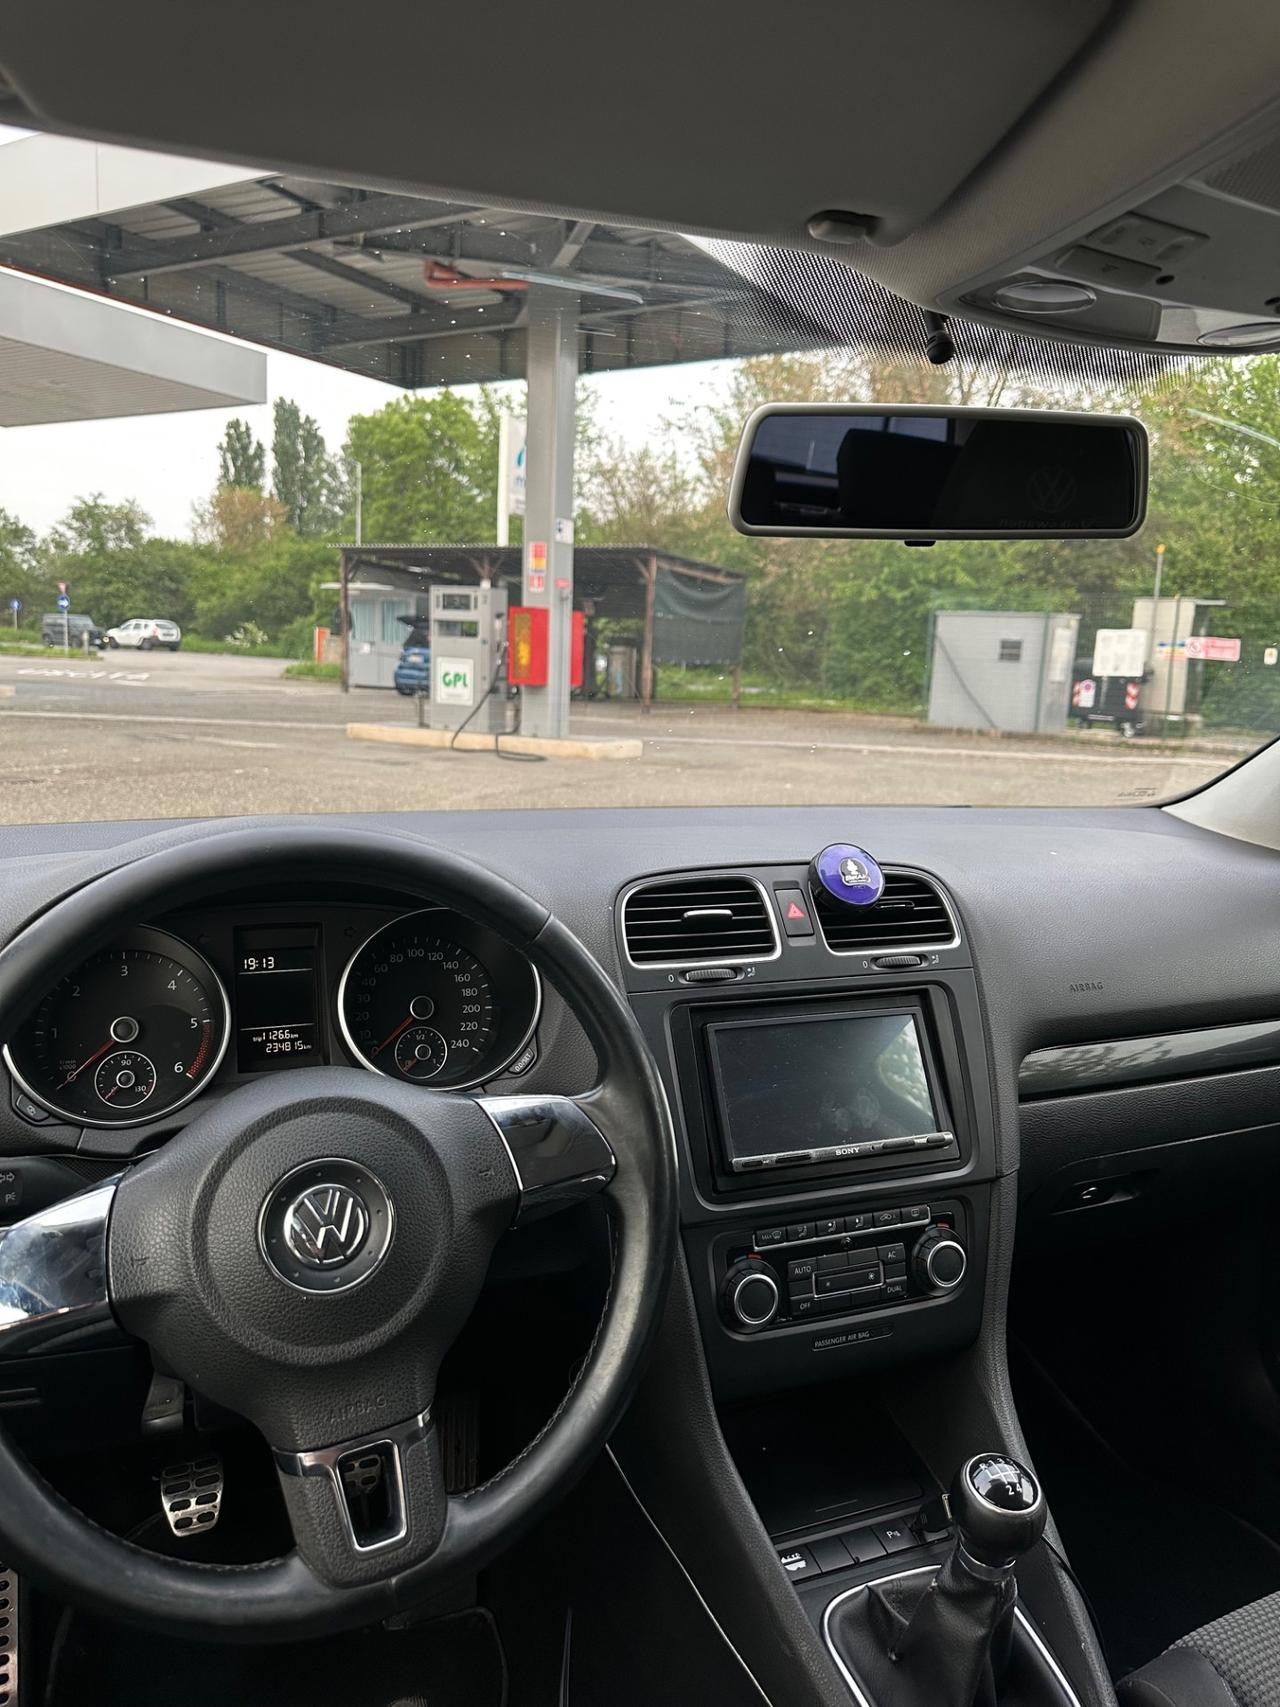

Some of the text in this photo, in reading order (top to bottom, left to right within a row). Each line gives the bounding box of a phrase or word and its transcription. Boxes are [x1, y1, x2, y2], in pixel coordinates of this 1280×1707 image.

[408, 948, 425, 958] 100
[428, 952, 444, 961] 120
[244, 956, 275, 970] 19:13
[443, 961, 459, 970] 140
[120, 965, 129, 977] 3
[454, 973, 471, 983] 160
[168, 980, 177, 991] 4
[73, 985, 81, 997] 2
[461, 987, 478, 997] 180
[462, 1004, 481, 1014] 200
[190, 1017, 198, 1029] 5
[460, 1021, 478, 1031] 220
[451, 1038, 470, 1049] 240
[174, 1061, 184, 1073] 6
[835, 1147, 860, 1156] SONY
[794, 1265, 812, 1275] AUTO
[799, 1302, 811, 1310] OFF
[814, 1335, 846, 1348] PASSENGER
[858, 1330, 870, 1338] BAG
[1005, 1482, 1023, 1496] 2 4
